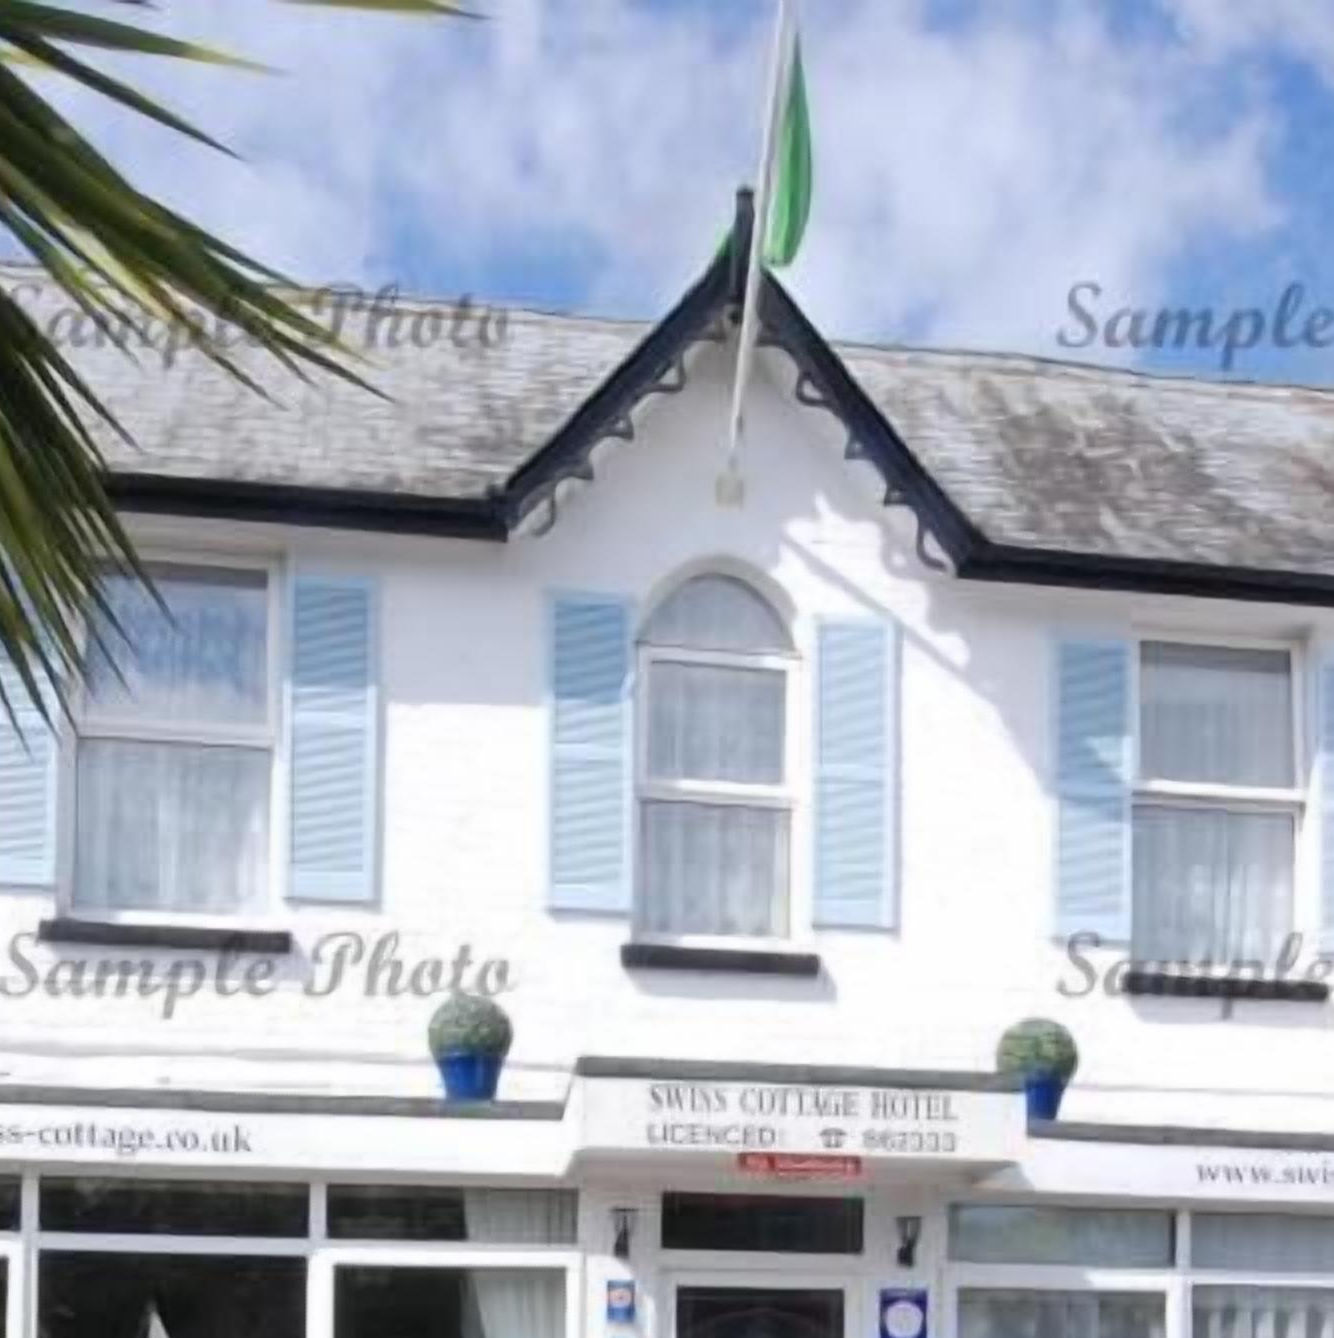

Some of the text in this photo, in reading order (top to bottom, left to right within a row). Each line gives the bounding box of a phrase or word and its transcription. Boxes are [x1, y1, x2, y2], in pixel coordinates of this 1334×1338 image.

[649, 1082, 959, 1122] SWISS COTTAGE HOTEL
